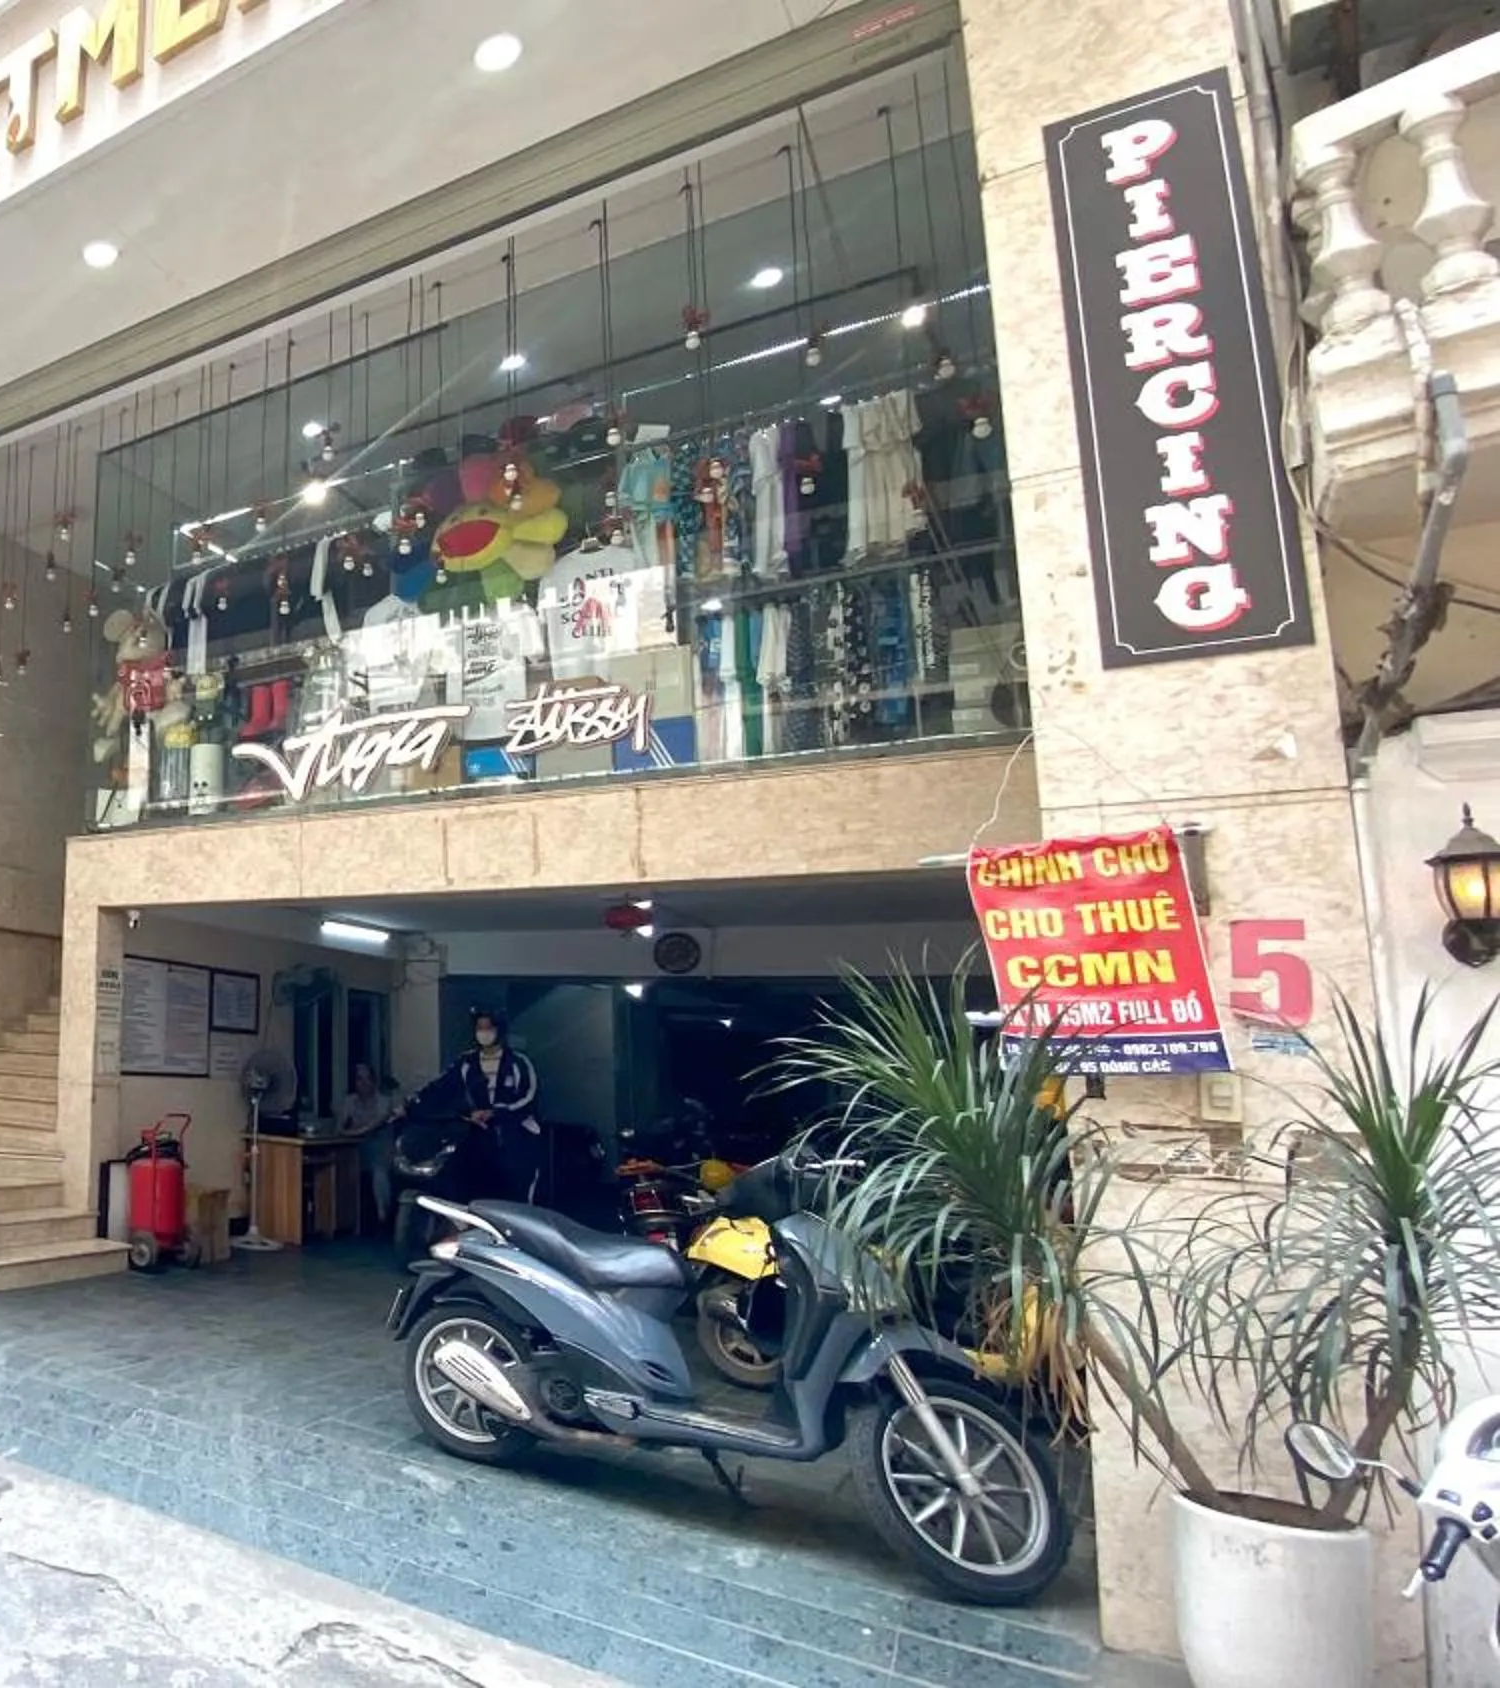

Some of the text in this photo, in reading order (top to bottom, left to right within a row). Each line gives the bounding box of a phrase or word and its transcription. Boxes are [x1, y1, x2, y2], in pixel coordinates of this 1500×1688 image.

[1101, 118, 1251, 632] PIERCING
[984, 890, 1180, 940] CHO THUÊ
[1007, 950, 1176, 988] CCMN
[1203, 919, 1312, 1029] 5
[1117, 999, 1168, 1023] FULL
